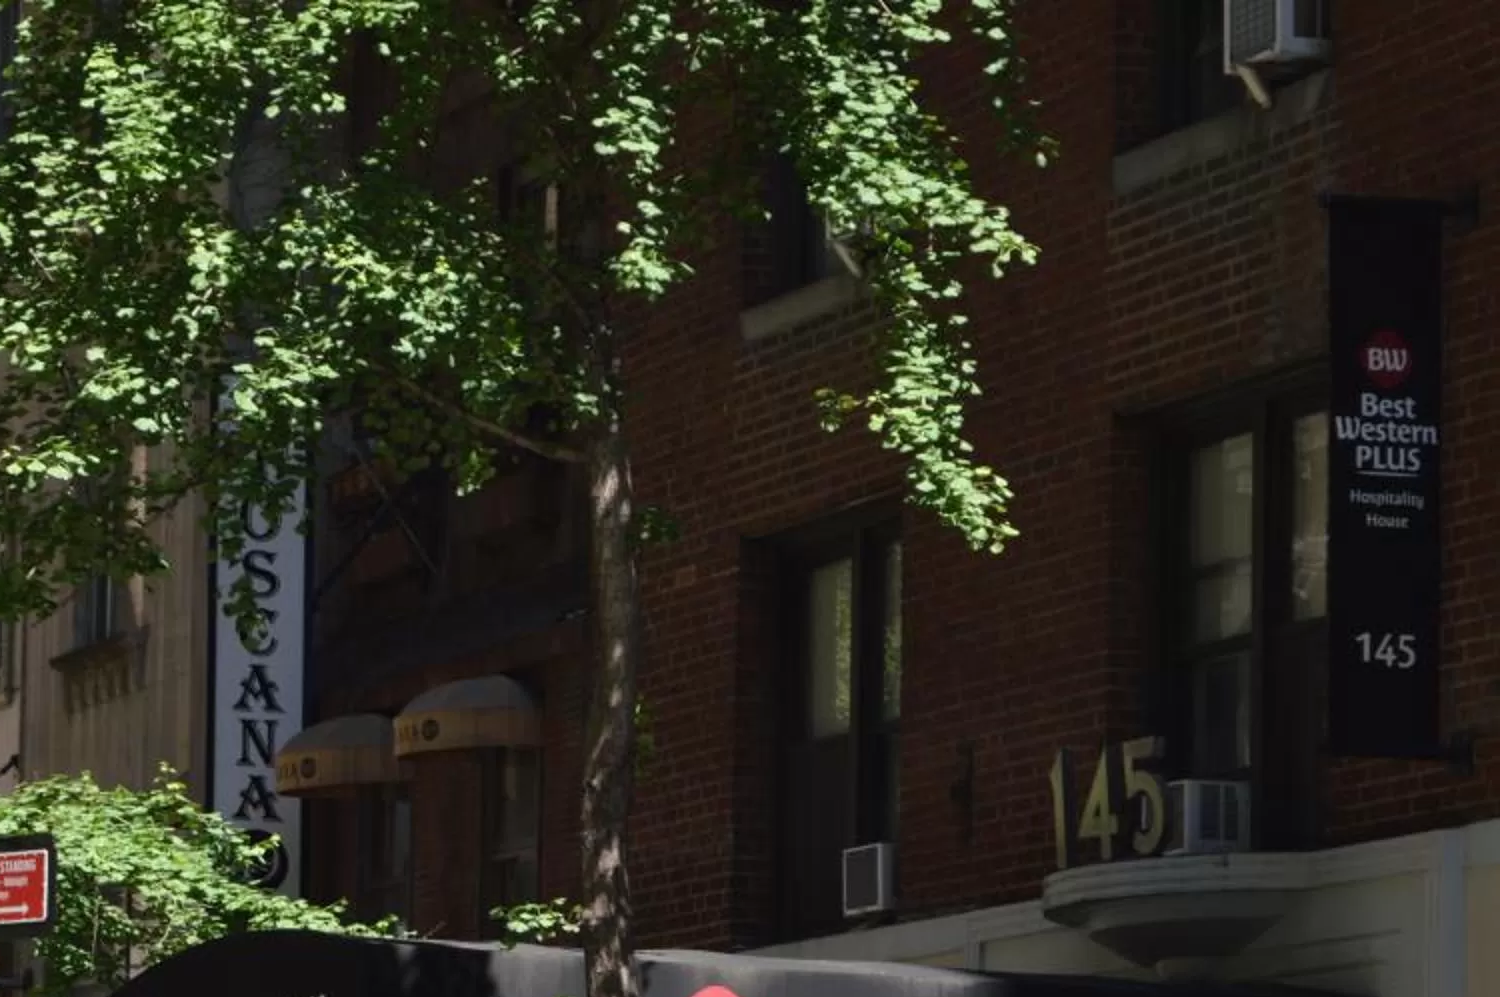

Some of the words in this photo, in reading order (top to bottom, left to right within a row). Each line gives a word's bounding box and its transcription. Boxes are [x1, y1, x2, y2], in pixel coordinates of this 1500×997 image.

[1367, 346, 1407, 372] BW
[1360, 391, 1417, 420] Best
[1334, 414, 1438, 446] Western
[1355, 445, 1421, 472] PLUS
[1349, 488, 1425, 511] Hospitality
[1365, 511, 1410, 530] House
[1354, 631, 1417, 669] 145
[1049, 735, 1164, 870] 145
